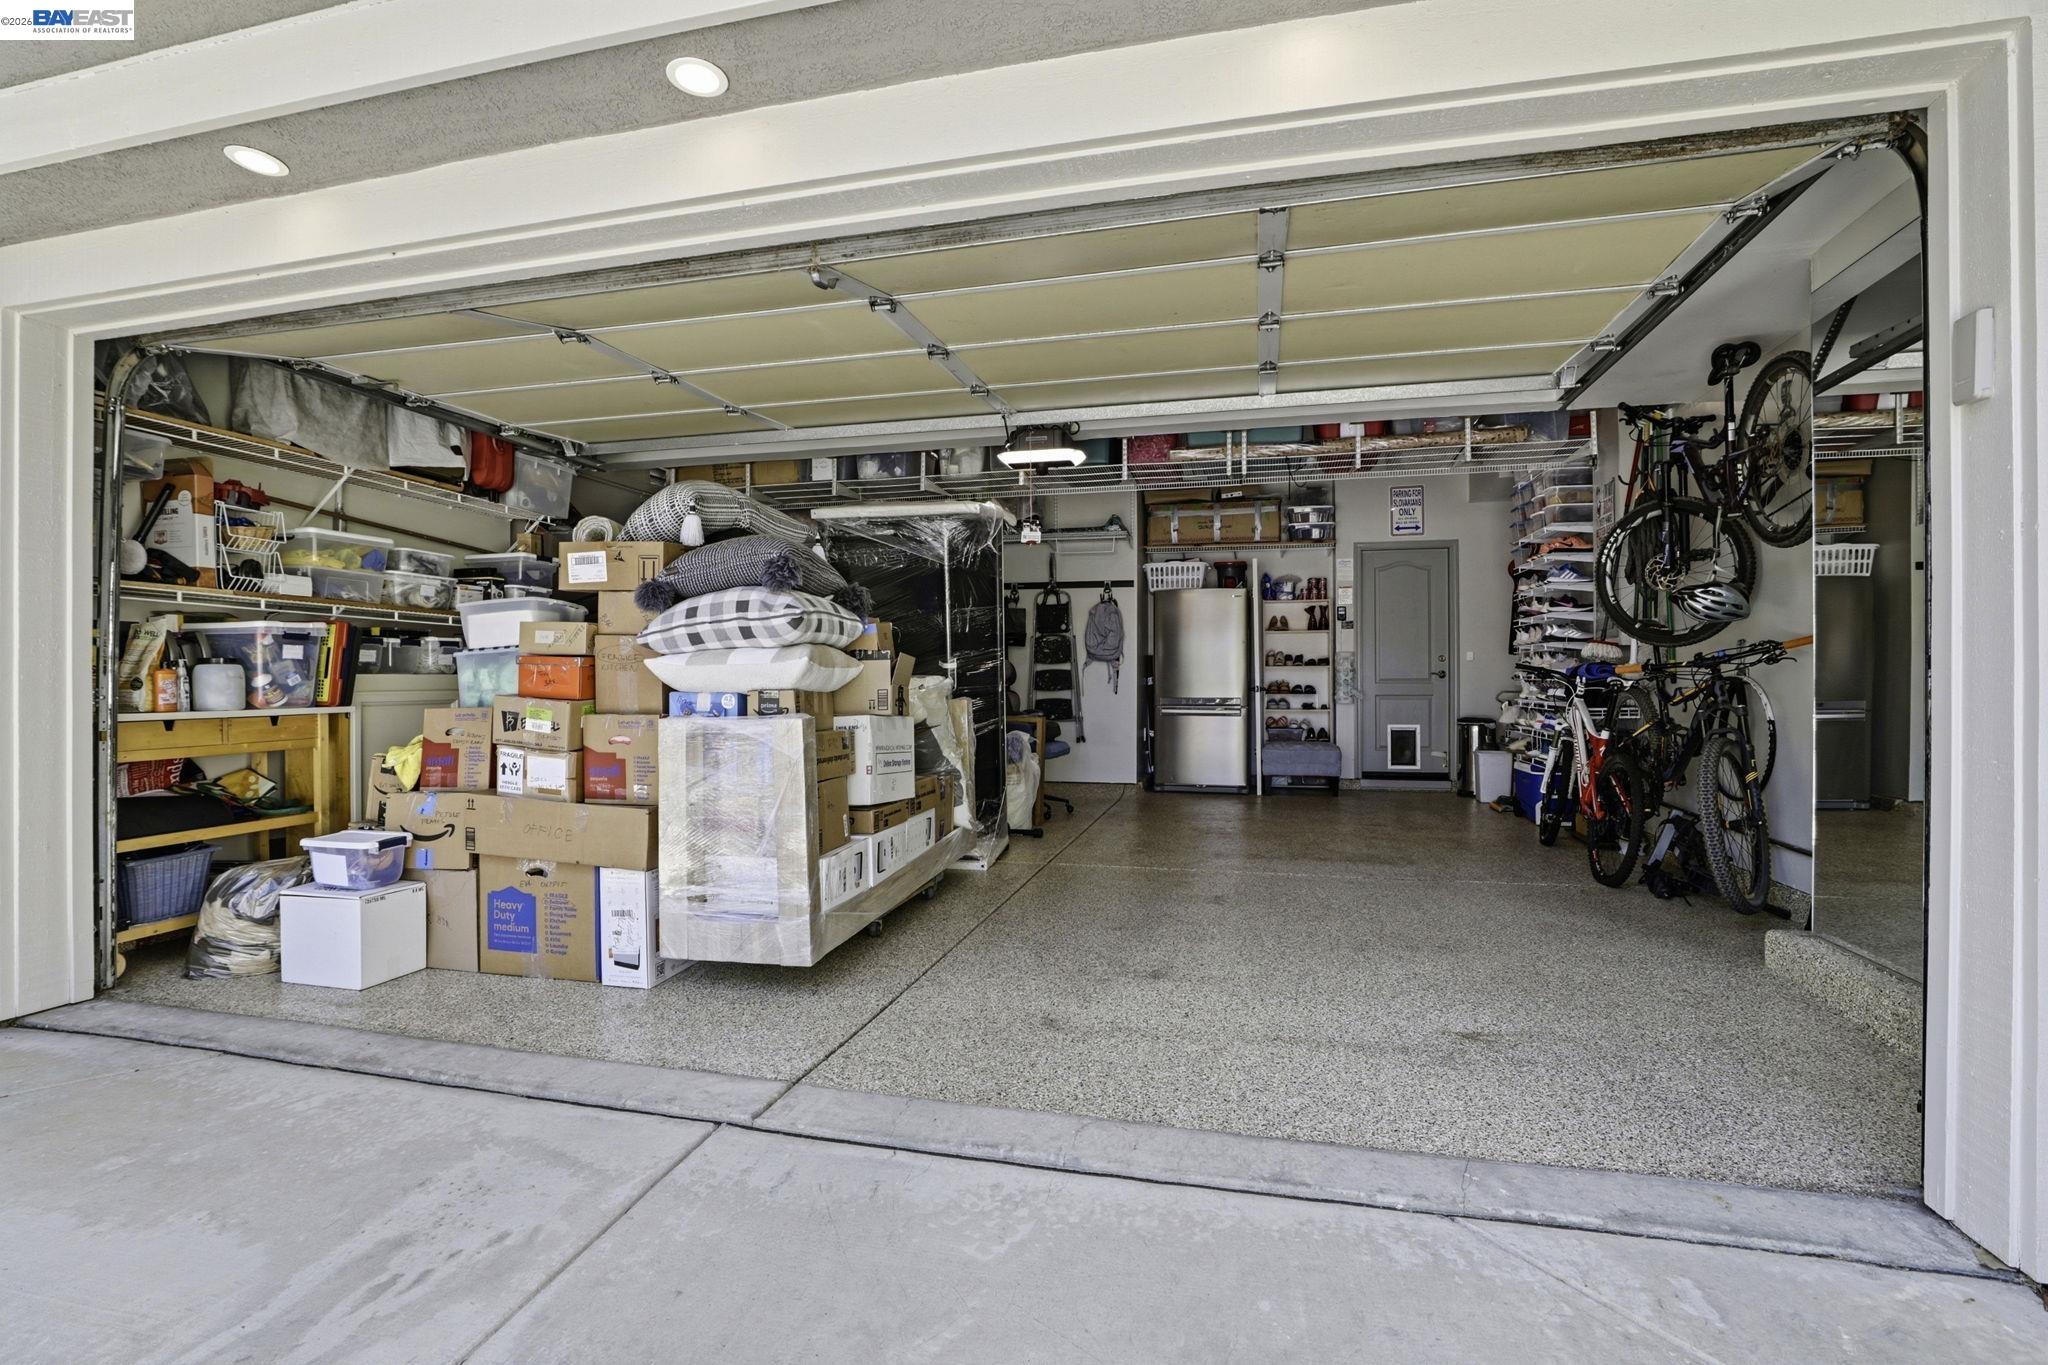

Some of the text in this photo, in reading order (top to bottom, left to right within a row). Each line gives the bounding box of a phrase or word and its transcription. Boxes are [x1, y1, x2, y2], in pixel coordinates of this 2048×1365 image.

[1393, 489, 1422, 498] PARKING FOR
[1398, 507, 1416, 516] ONLY
[500, 750, 523, 759] FRAGILE
[523, 824, 573, 842] OFFICE
[494, 898, 523, 912] Heavy
[494, 909, 515, 921] Duty
[494, 923, 529, 933] medium
